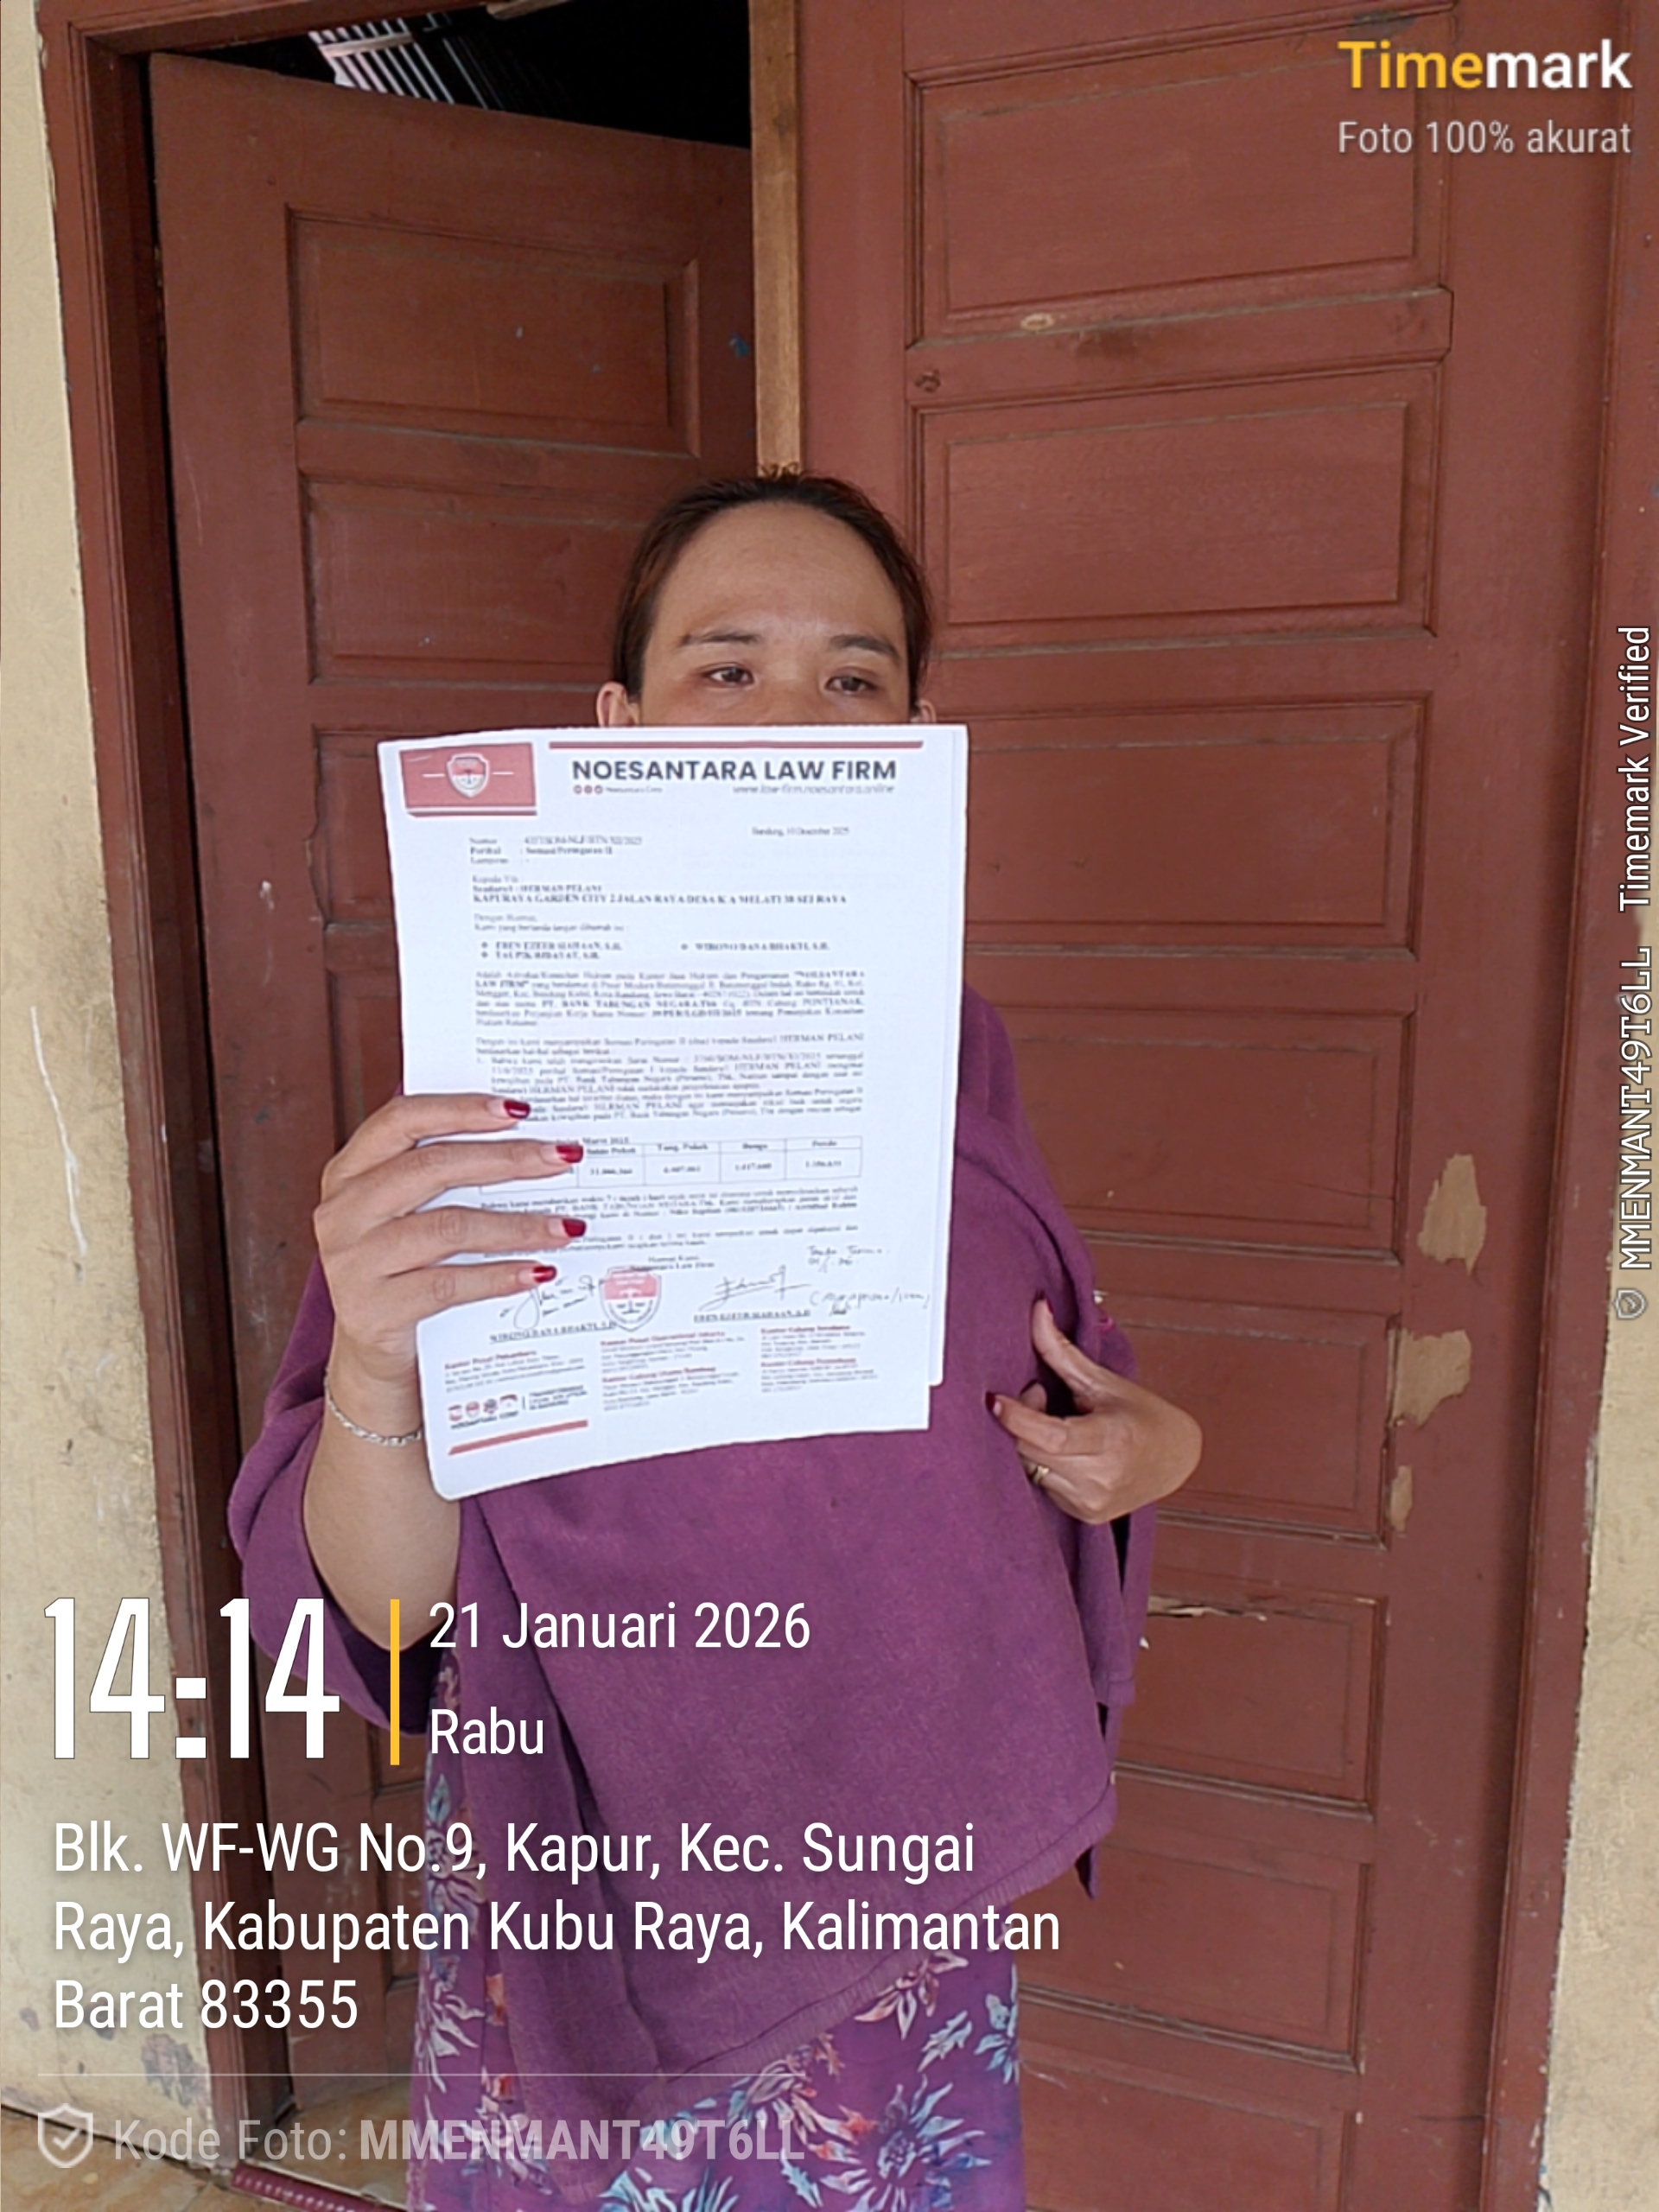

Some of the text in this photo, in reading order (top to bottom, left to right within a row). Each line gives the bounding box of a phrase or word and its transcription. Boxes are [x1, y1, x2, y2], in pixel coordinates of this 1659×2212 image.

[571, 760, 897, 781] NOESANTARA LAW FIRM
